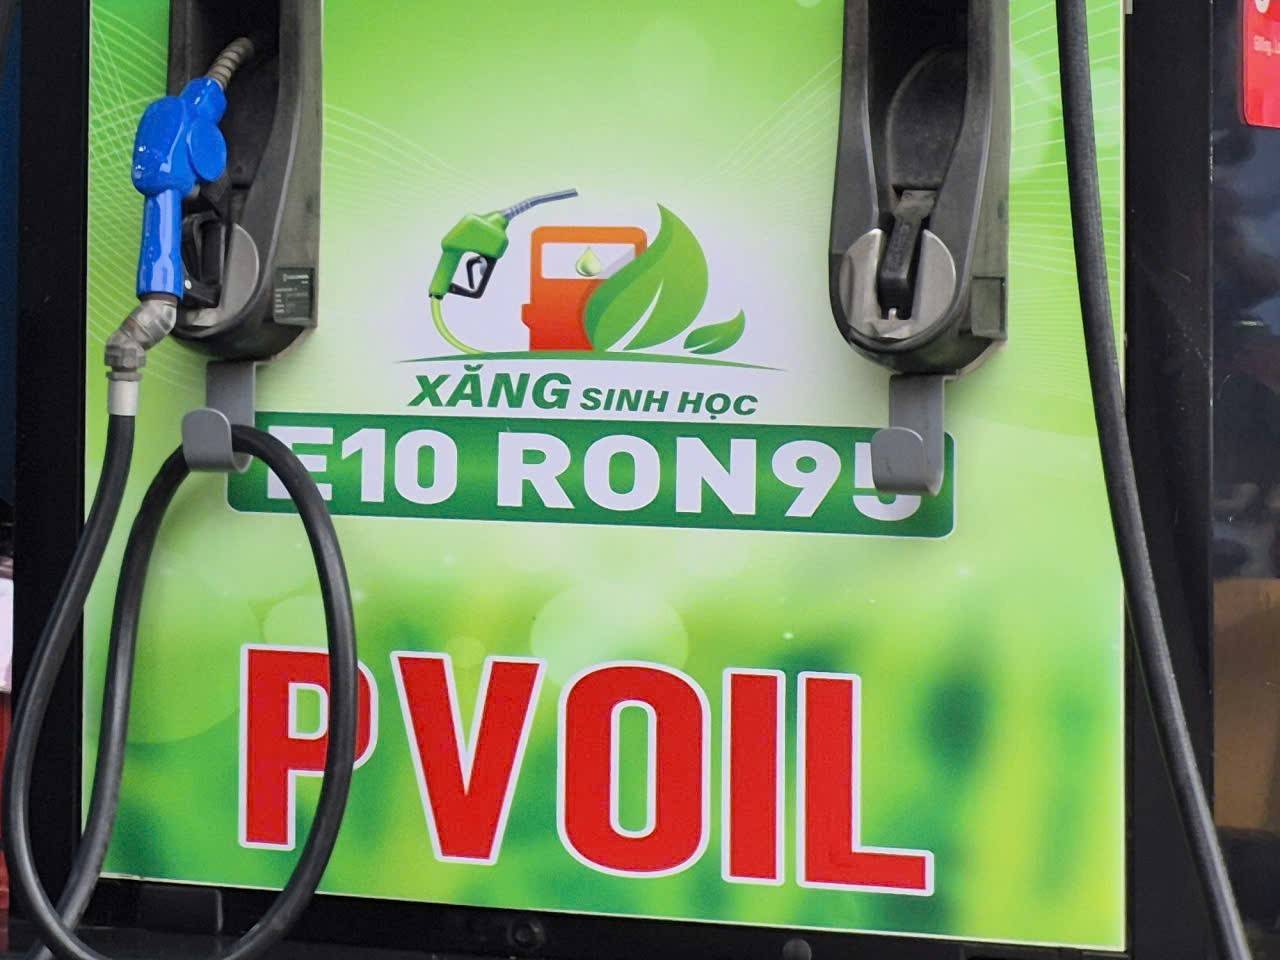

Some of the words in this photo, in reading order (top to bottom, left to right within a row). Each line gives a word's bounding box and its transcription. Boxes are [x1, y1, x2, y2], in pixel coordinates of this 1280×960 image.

[407, 363, 573, 409] XĂNG
[580, 387, 669, 413] SINH
[677, 391, 758, 421] HỌC
[267, 425, 458, 505] E10
[239, 644, 934, 897] PVOIL
